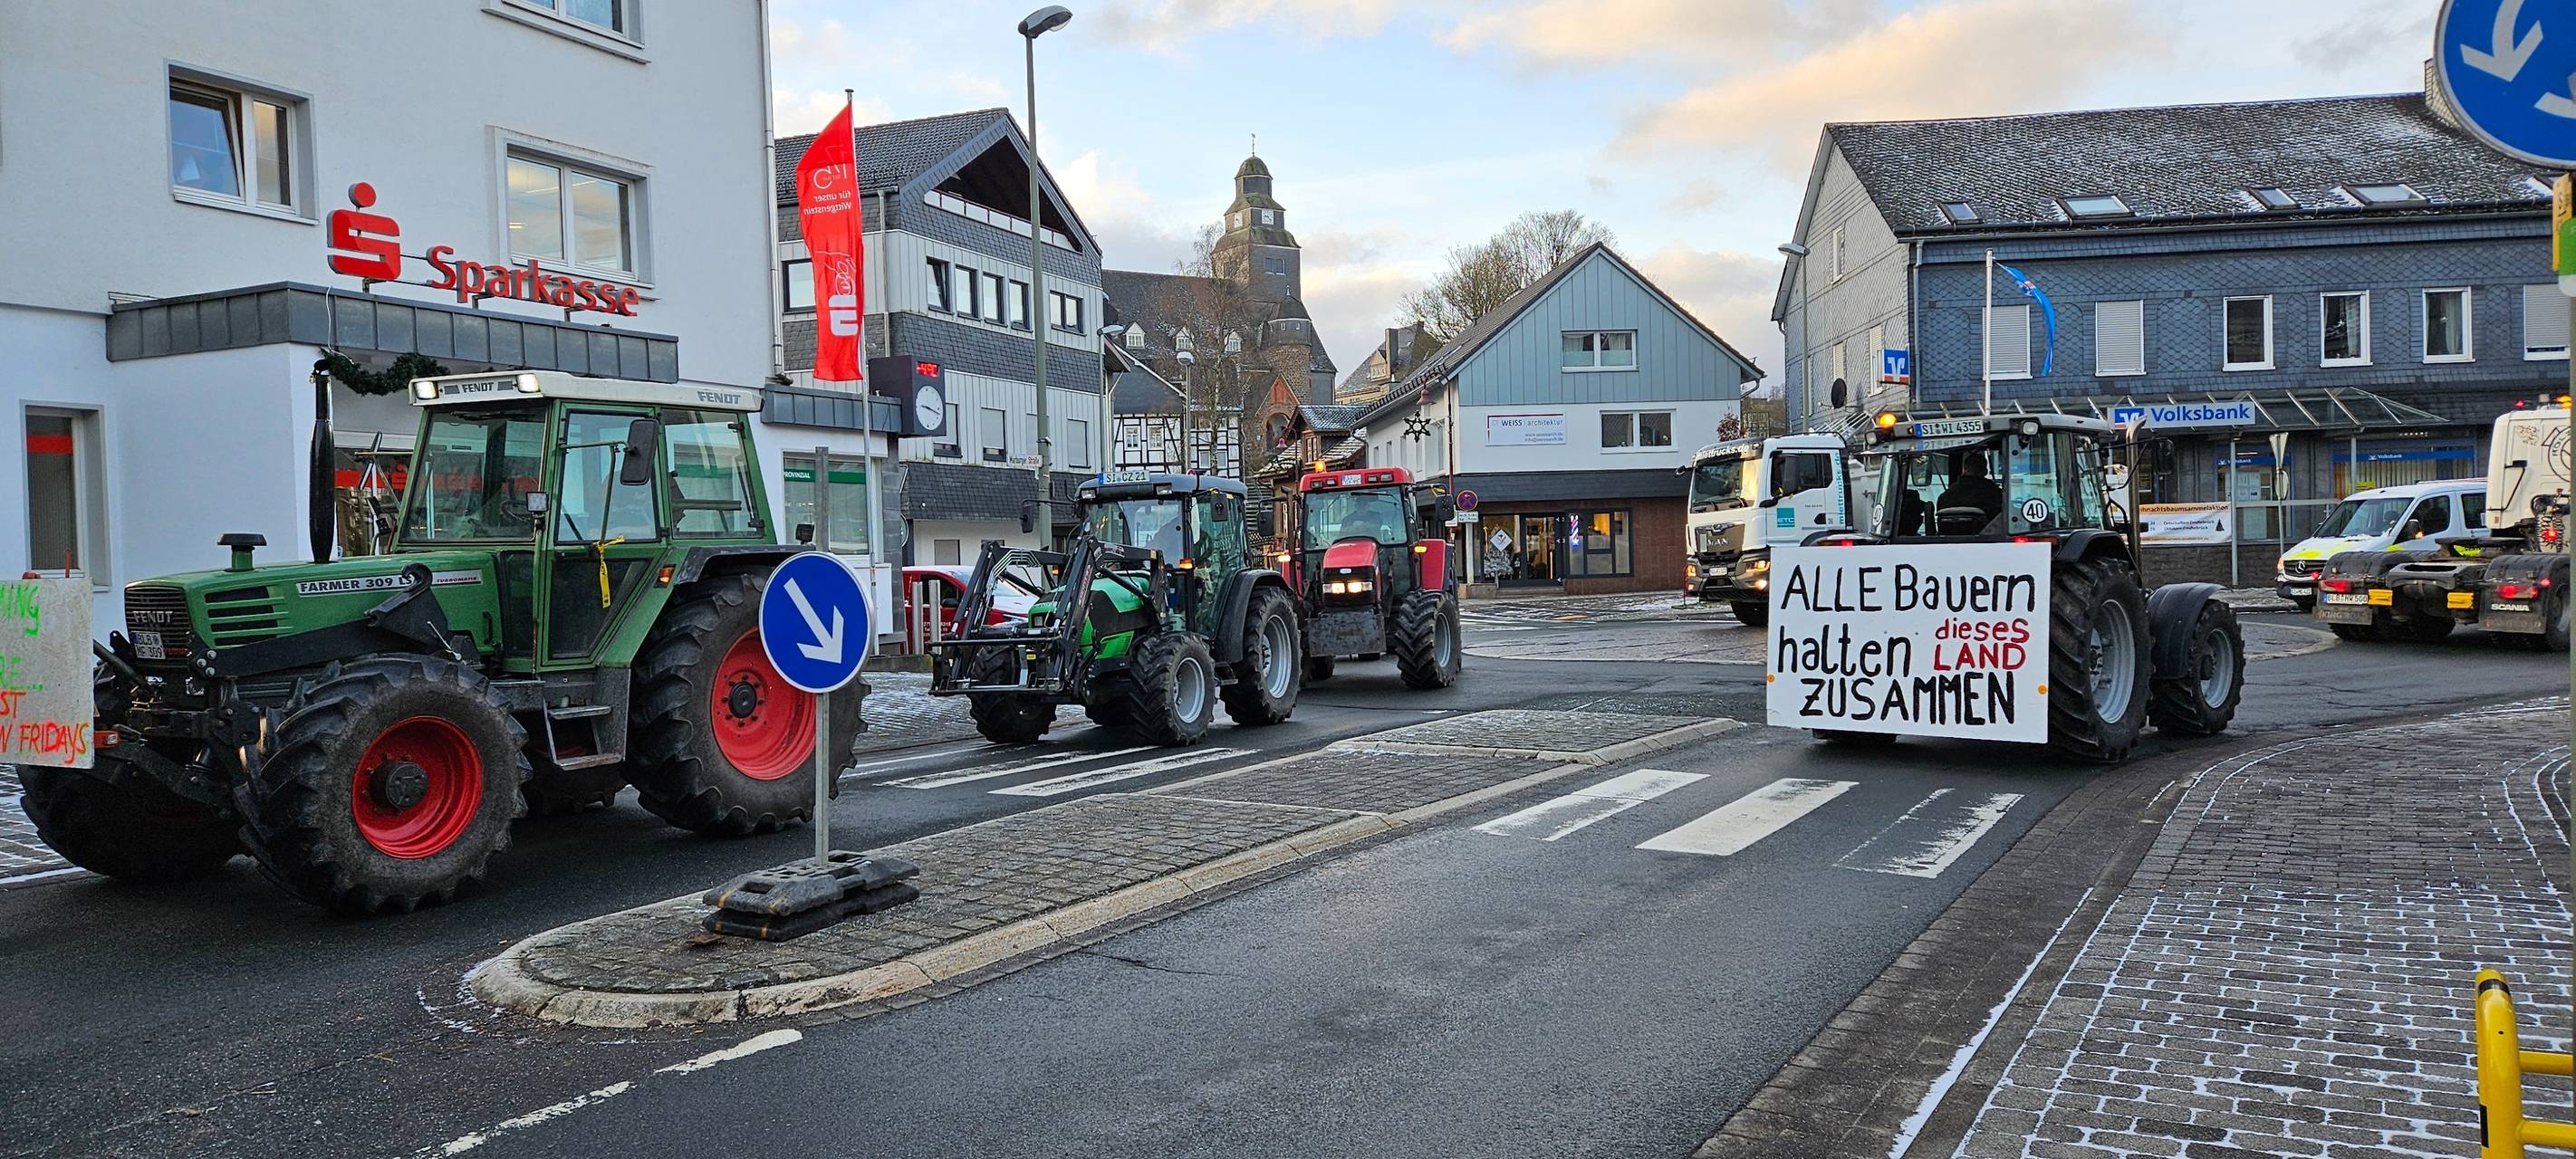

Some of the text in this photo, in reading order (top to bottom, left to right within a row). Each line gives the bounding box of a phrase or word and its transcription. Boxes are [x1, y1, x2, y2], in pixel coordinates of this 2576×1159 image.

[426, 244, 639, 317] Sparkasse
[462, 381, 495, 393] FENDT
[697, 390, 742, 405] FENDT
[2151, 403, 2250, 422] Volksbank
[1922, 425, 1935, 435] SI
[1956, 420, 1981, 433] 4355
[1106, 472, 1146, 483] SI CZ 21
[2026, 503, 2043, 519] 40
[300, 578, 360, 592] FARMER
[366, 577, 393, 588] 309
[1781, 563, 2035, 612] ALLE Bauern
[0, 581, 42, 636] ING
[132, 610, 173, 623] FENDT
[2491, 603, 2530, 611] SCANIA
[1935, 618, 2030, 644] dieses
[1777, 623, 1911, 677] halten
[1934, 643, 2026, 671] LAND
[1799, 671, 2014, 725] ZUSAMMEN
[19, 722, 89, 764] FRIDAYS
